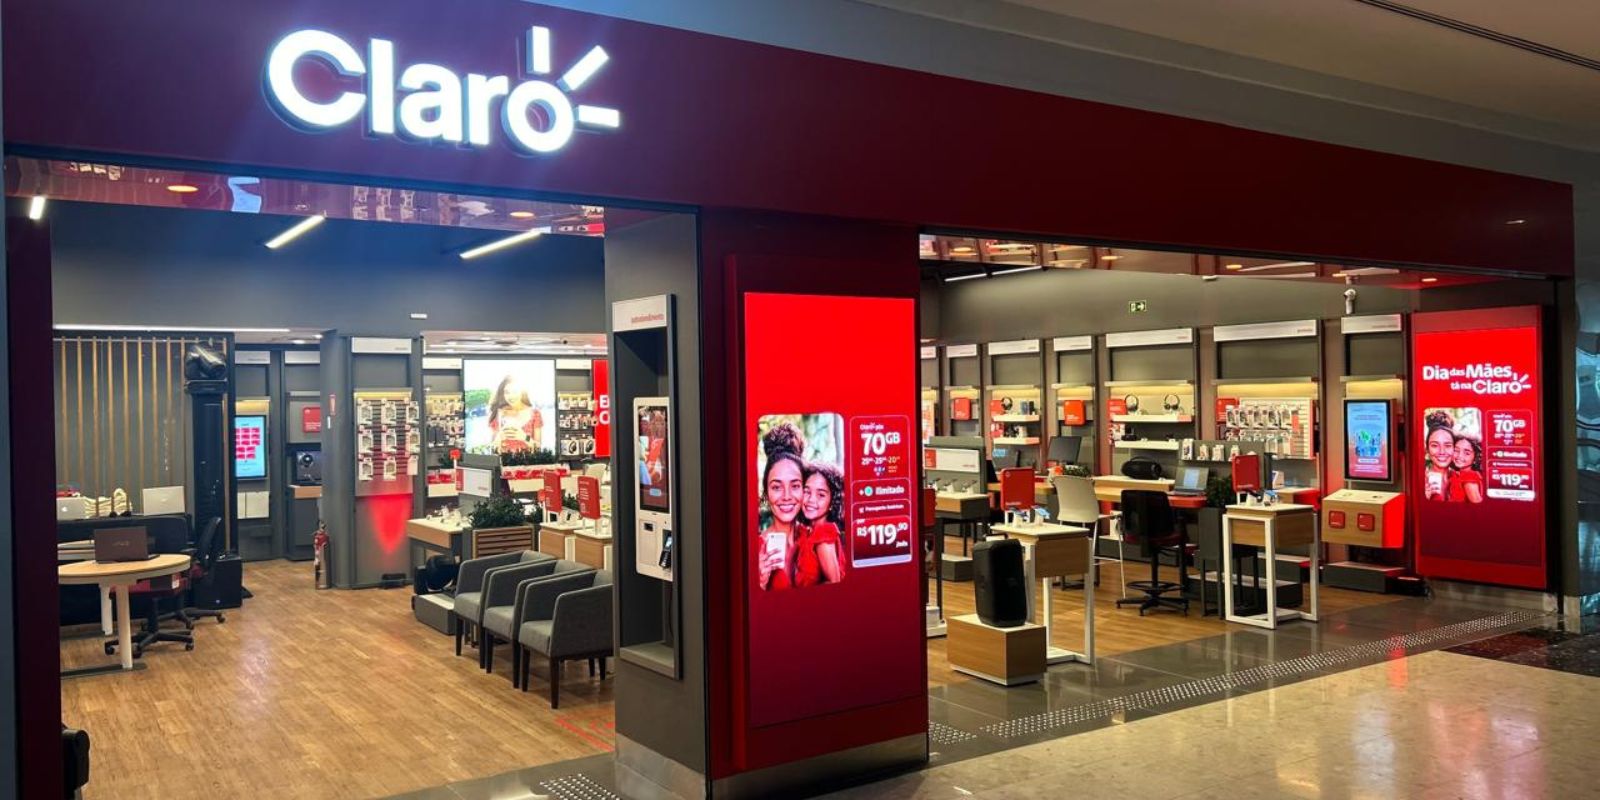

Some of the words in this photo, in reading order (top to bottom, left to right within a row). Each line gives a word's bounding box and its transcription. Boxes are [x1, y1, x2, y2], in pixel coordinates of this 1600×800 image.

[263, 28, 582, 153] Claro
[1423, 365, 1449, 380] Dia
[1465, 363, 1512, 378] Mães
[1472, 377, 1523, 395] Claro
